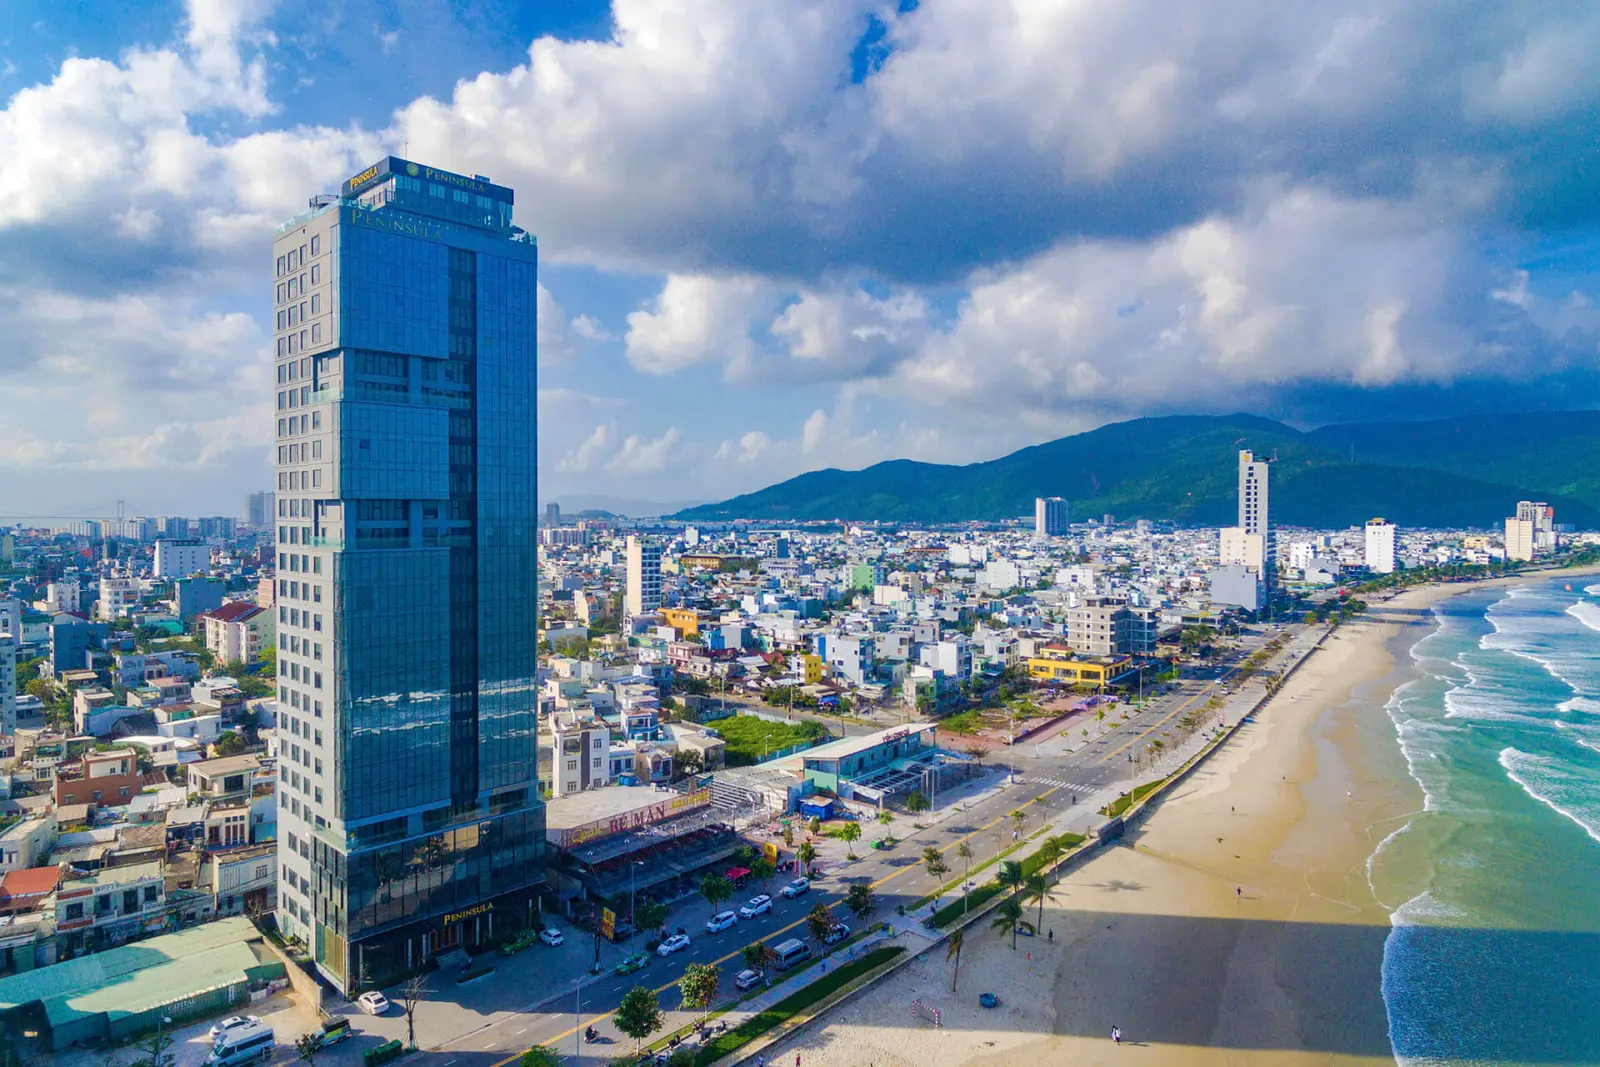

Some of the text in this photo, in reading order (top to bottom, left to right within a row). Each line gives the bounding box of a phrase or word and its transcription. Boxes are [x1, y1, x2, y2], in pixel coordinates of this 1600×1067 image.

[350, 166, 378, 190] PENINSULA
[426, 168, 485, 192] PENINSULA
[352, 209, 443, 239] PENINSULA
[443, 902, 494, 926] PENINSULA
